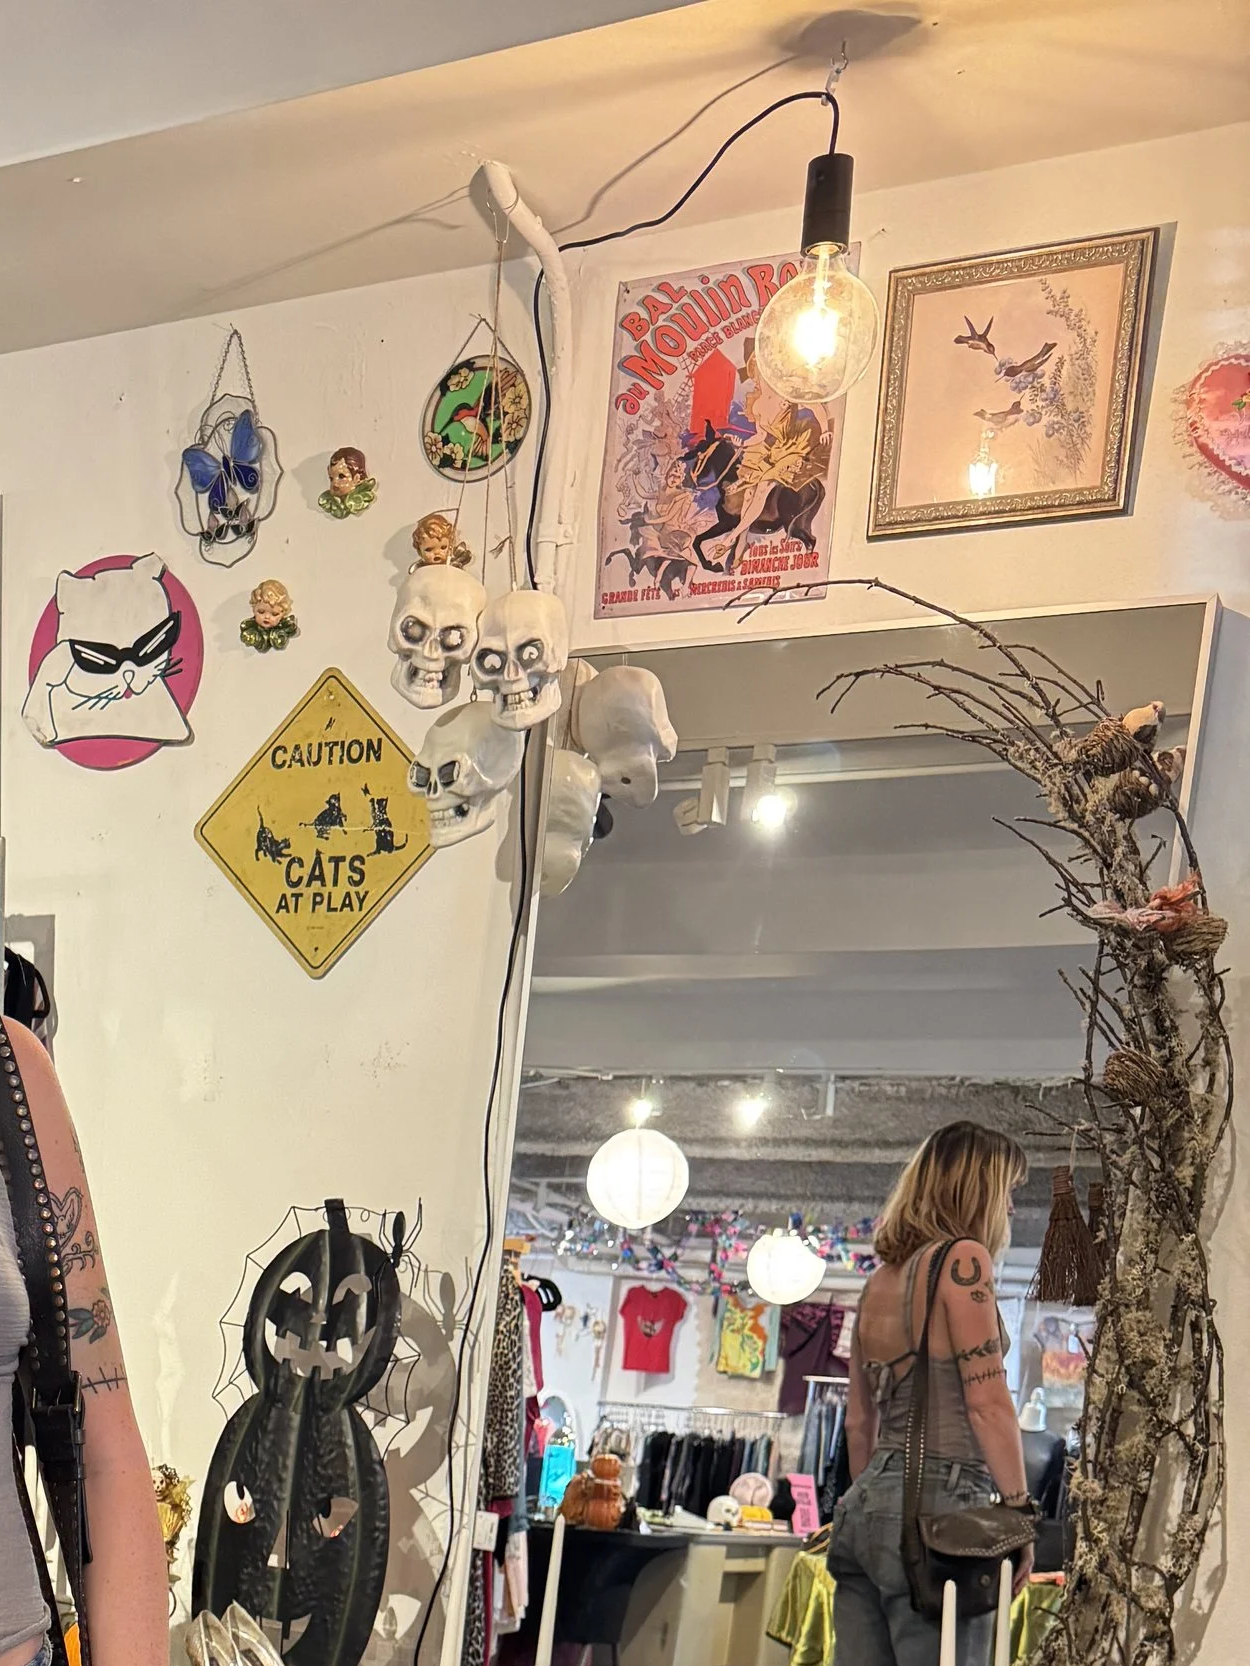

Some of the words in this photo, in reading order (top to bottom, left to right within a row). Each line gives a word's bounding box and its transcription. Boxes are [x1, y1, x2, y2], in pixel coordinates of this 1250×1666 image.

[621, 282, 688, 342] BAL
[722, 309, 763, 339] BLANC
[790, 551, 819, 570] JOUR
[601, 589, 638, 605] GRANDE
[271, 737, 383, 769] CAUTION
[284, 854, 367, 889] CATS
[275, 892, 303, 914] AT
[311, 890, 369, 914] PLAY
